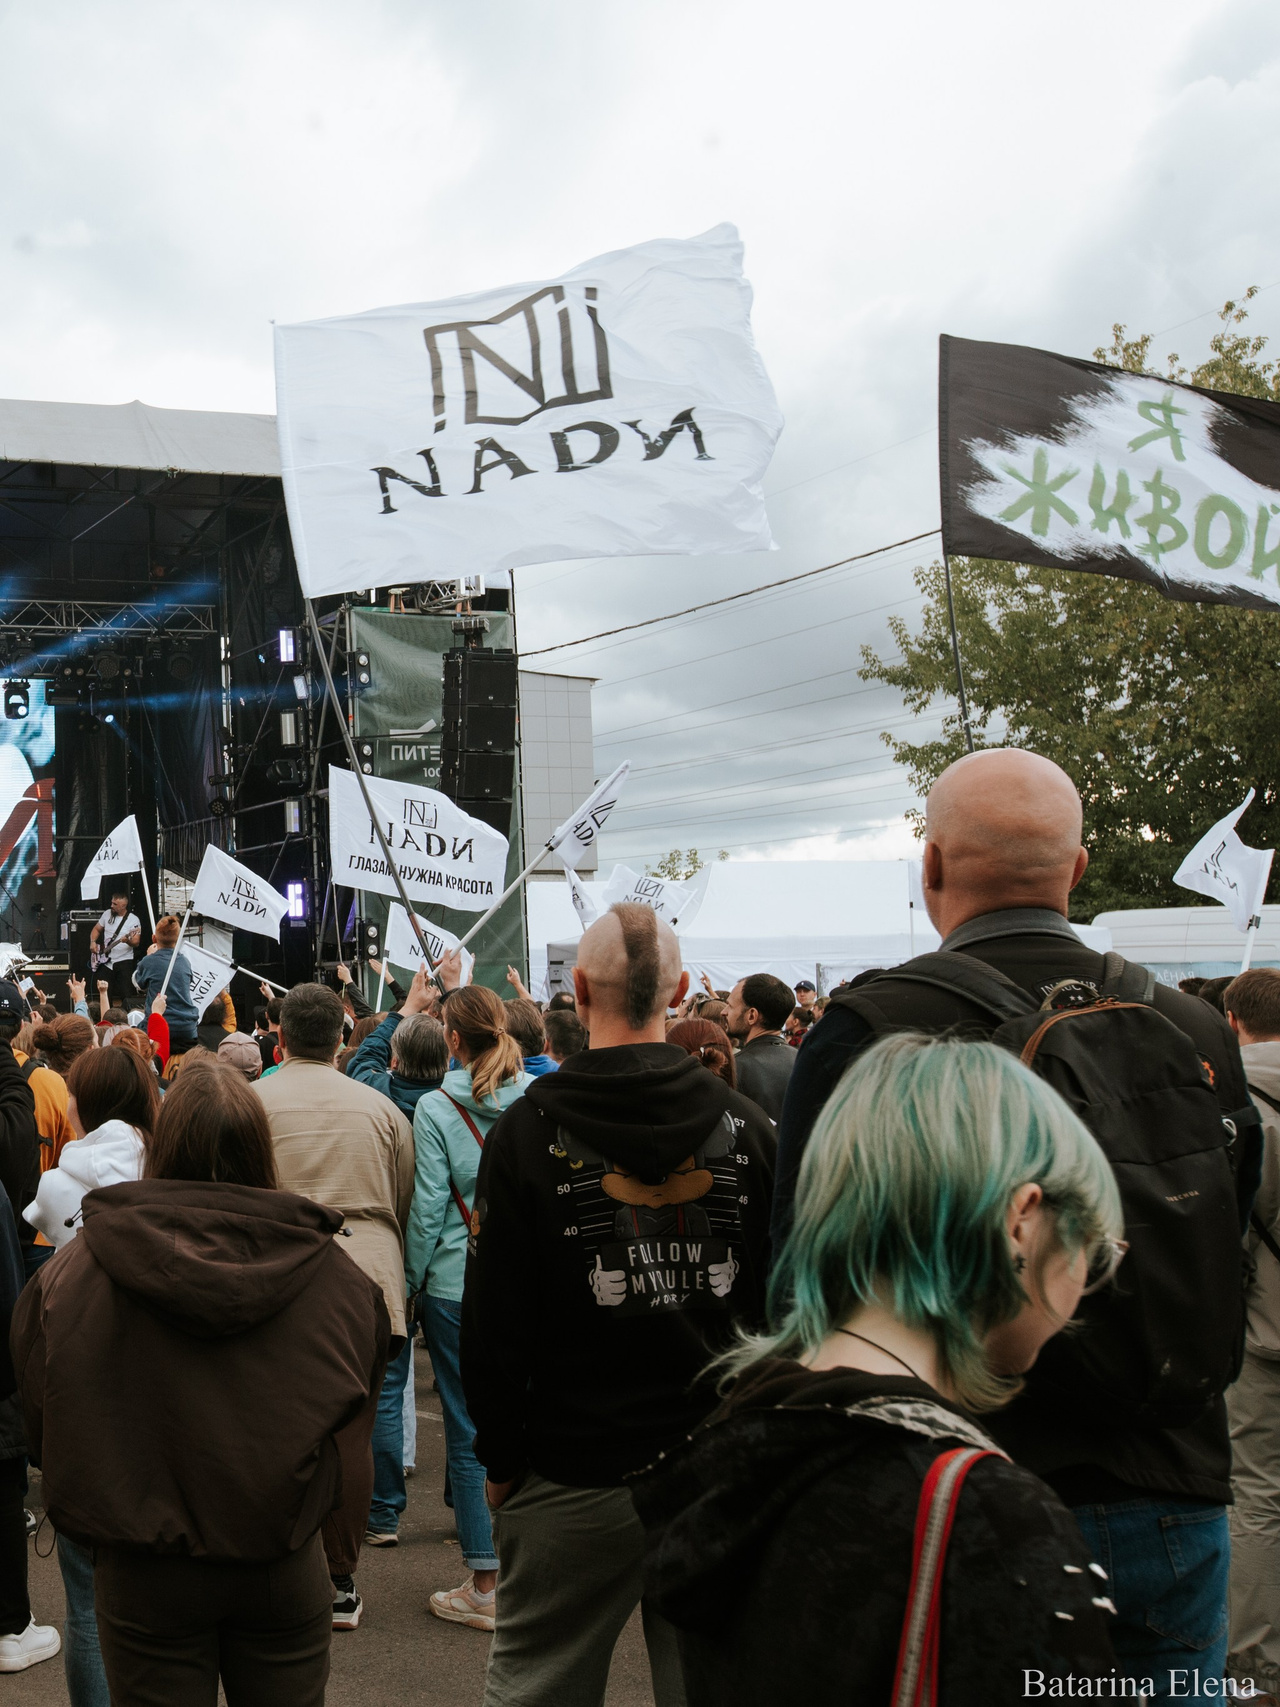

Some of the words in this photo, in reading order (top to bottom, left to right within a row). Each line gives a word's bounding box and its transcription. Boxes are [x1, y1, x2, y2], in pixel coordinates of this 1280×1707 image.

[1127, 390, 1189, 461] Я
[398, 864, 443, 887] НУЖНА
[445, 874, 494, 896] КРАСОТА
[736, 1154, 749, 1166] 53
[557, 1183, 571, 1195] 50
[738, 1195, 749, 1205] 46
[564, 1226, 578, 1237] 40
[627, 1242, 702, 1267] FOLLOW
